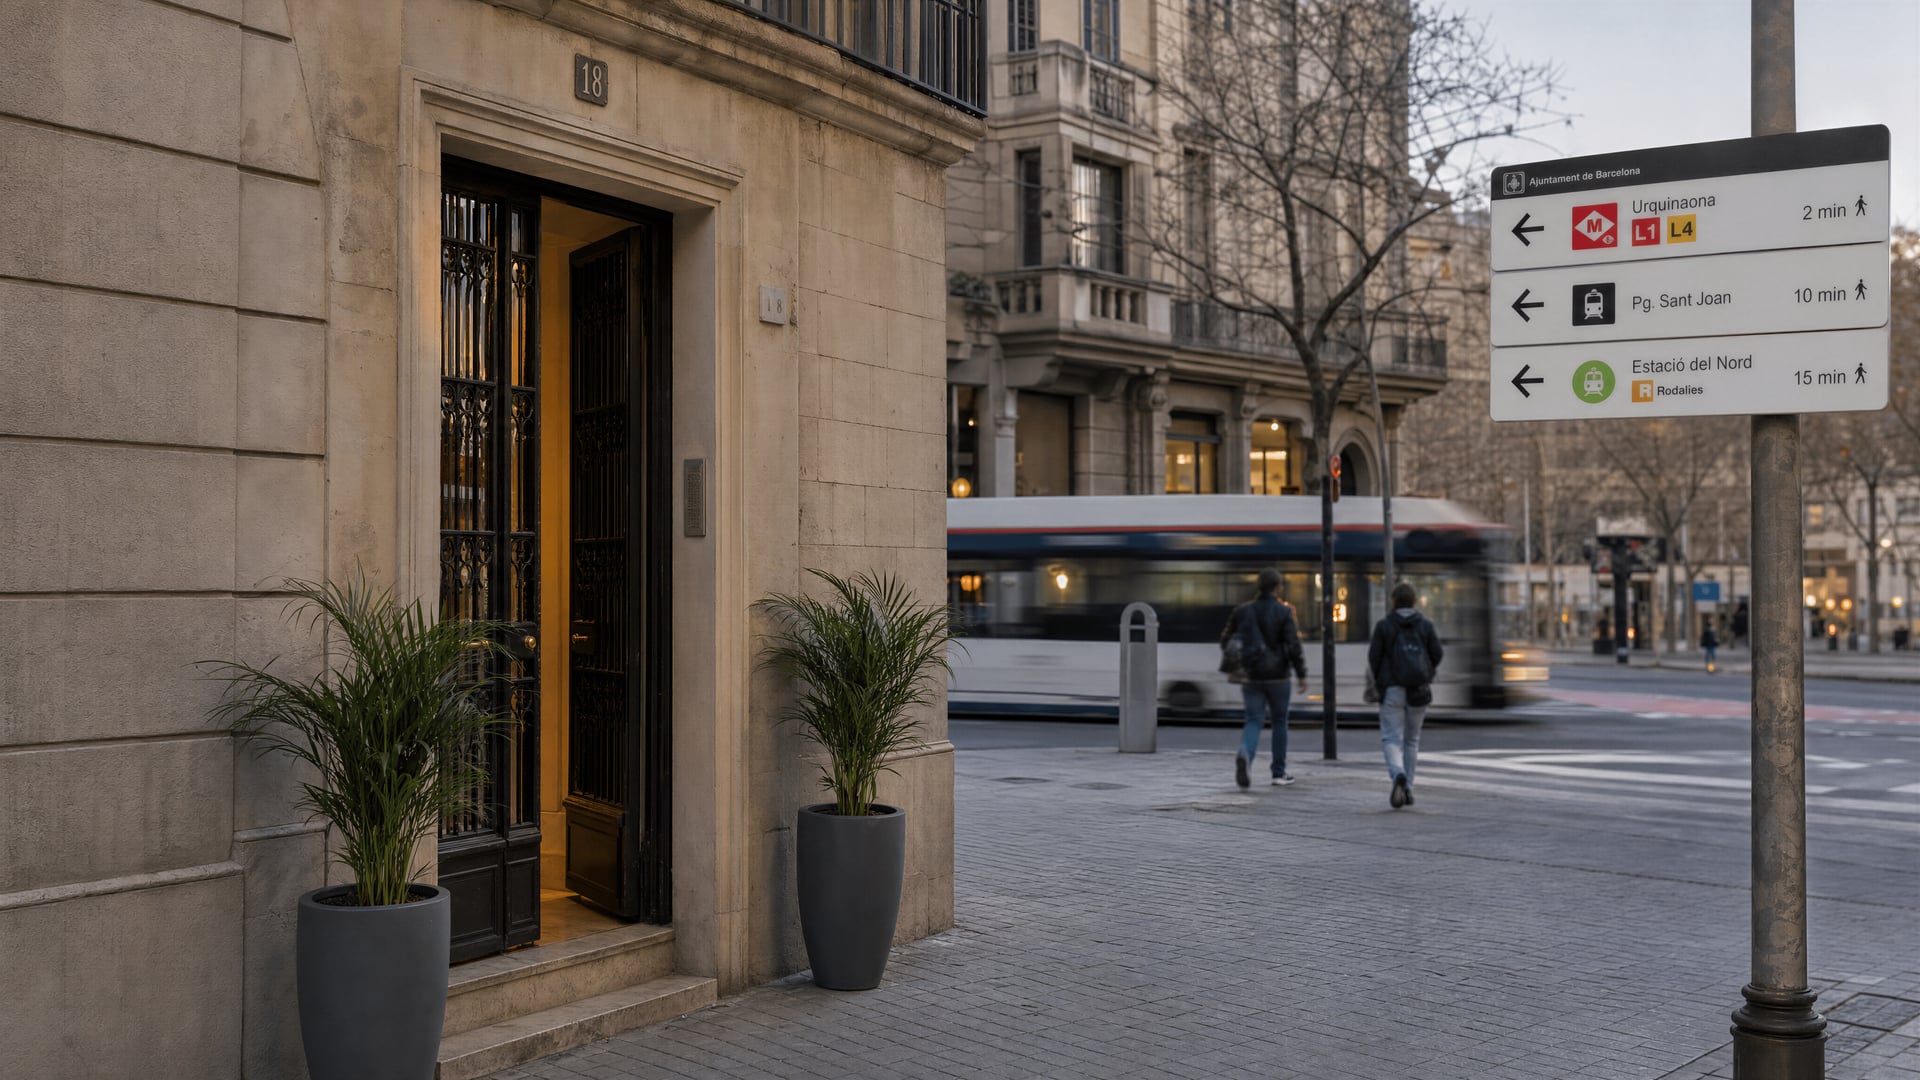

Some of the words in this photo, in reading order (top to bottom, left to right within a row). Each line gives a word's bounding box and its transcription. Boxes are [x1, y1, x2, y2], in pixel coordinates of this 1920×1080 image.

[582, 62, 602, 98] 18
[1528, 172, 1581, 187] Ajuntament
[1582, 171, 1594, 181] de
[1596, 167, 1641, 180] Barcelona
[1632, 195, 1716, 216] Urquinaona
[1802, 205, 1813, 221] 2
[1817, 203, 1847, 220] min
[1586, 217, 1603, 234] M
[1635, 223, 1656, 241] L1
[1670, 220, 1694, 238] L4
[1632, 295, 1655, 313] Pg.
[1659, 293, 1693, 308] Sant
[1696, 291, 1732, 307] Joan
[1794, 287, 1813, 303] 10
[1817, 286, 1847, 302] min
[1632, 357, 1686, 374] Estació
[1689, 356, 1711, 372] del
[1716, 354, 1753, 371] Nord
[1794, 369, 1813, 386] 15
[1817, 368, 1847, 385] min
[1657, 384, 1704, 397] Rodalies
